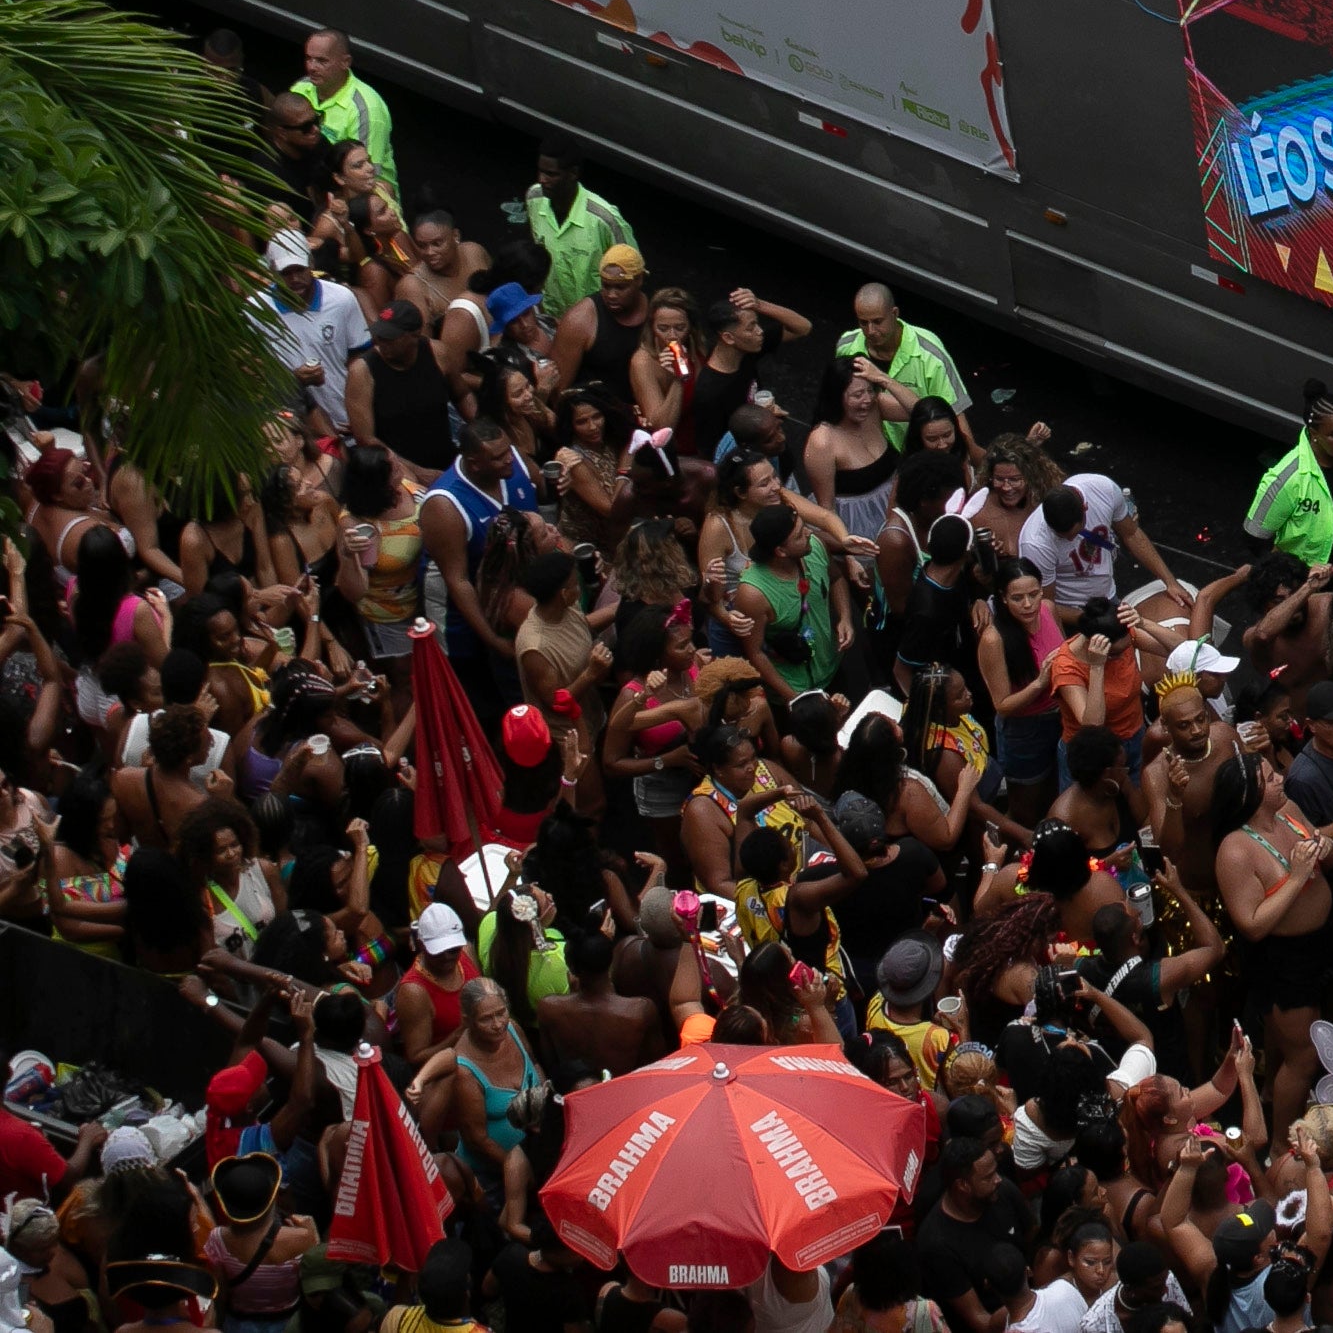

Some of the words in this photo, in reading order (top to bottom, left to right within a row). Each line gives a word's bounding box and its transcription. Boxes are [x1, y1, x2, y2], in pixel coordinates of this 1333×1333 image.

[587, 1110, 676, 1212] BRAHMA
[750, 1110, 838, 1212] BRAHMA
[669, 1265, 729, 1284] BRAHMA
